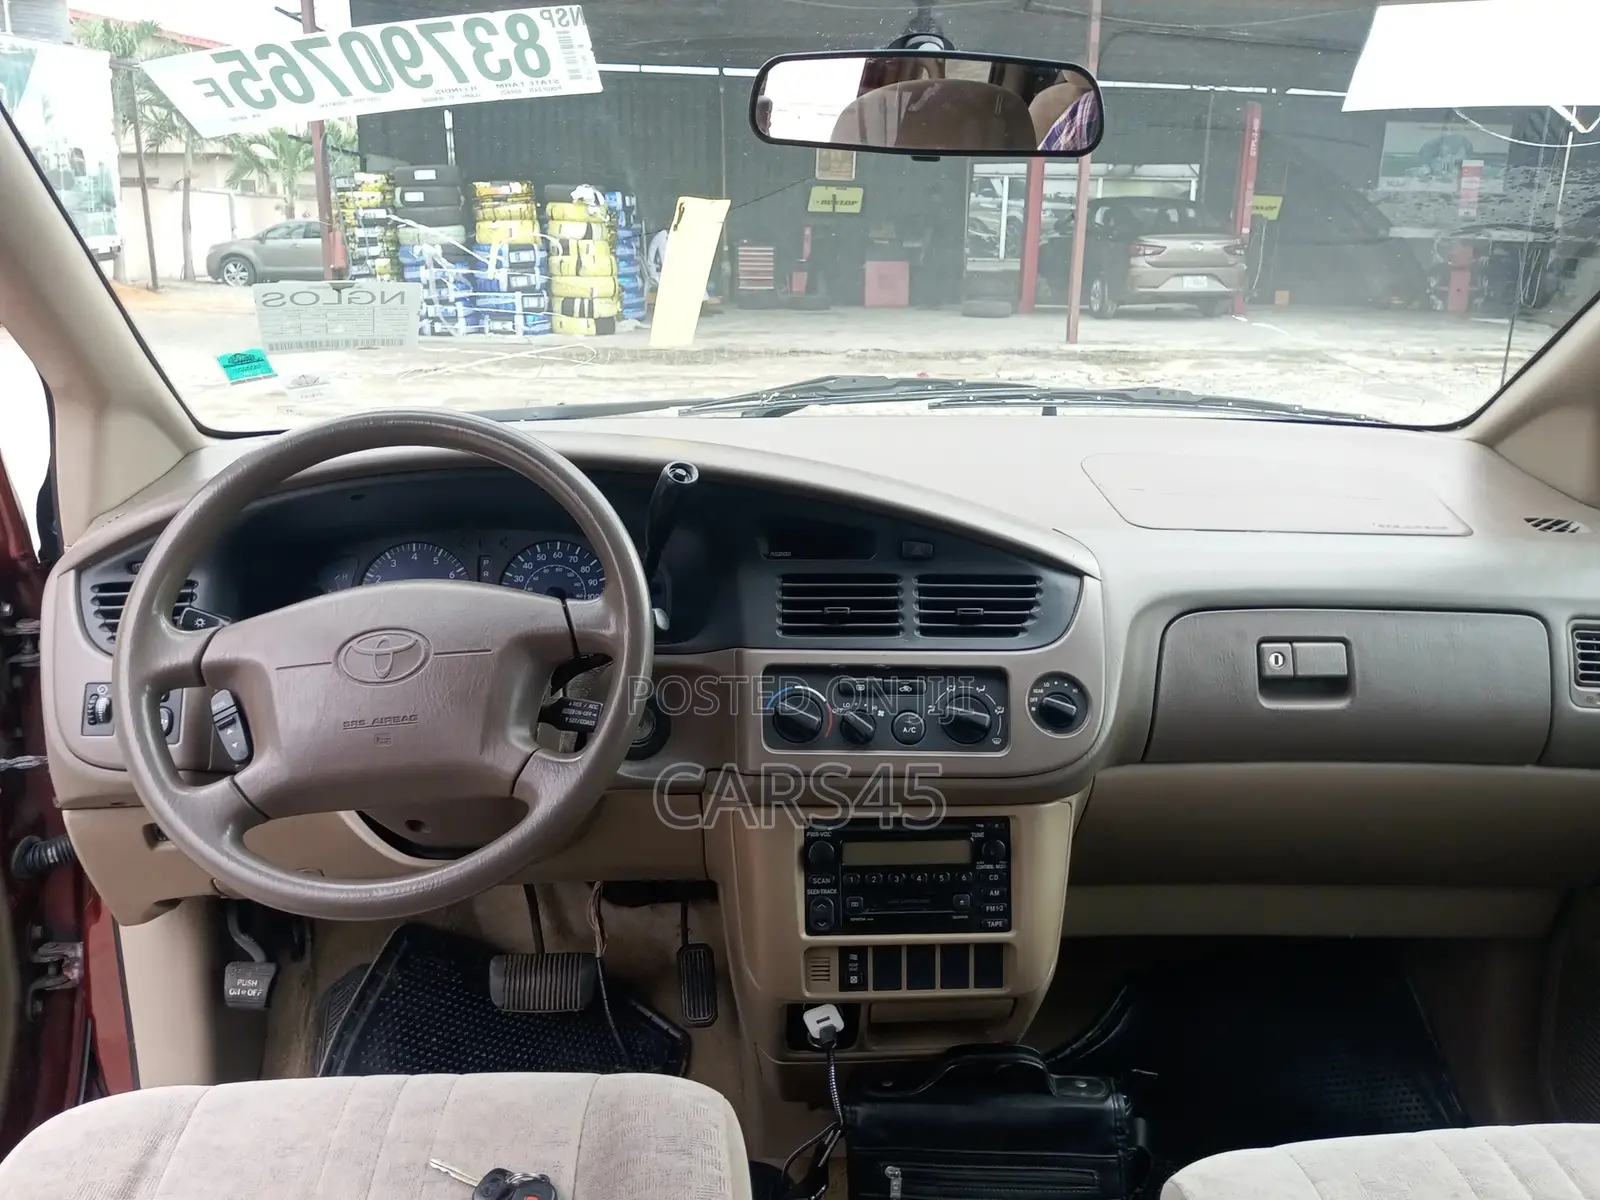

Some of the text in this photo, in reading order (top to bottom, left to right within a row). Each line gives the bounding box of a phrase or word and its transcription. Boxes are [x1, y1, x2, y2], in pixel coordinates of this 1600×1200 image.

[580, 565, 590, 573] 80
[449, 571, 455, 579] 6
[372, 714, 418, 725] AIRBAG
[237, 979, 258, 987] PUSH
[247, 988, 262, 996] OFF
